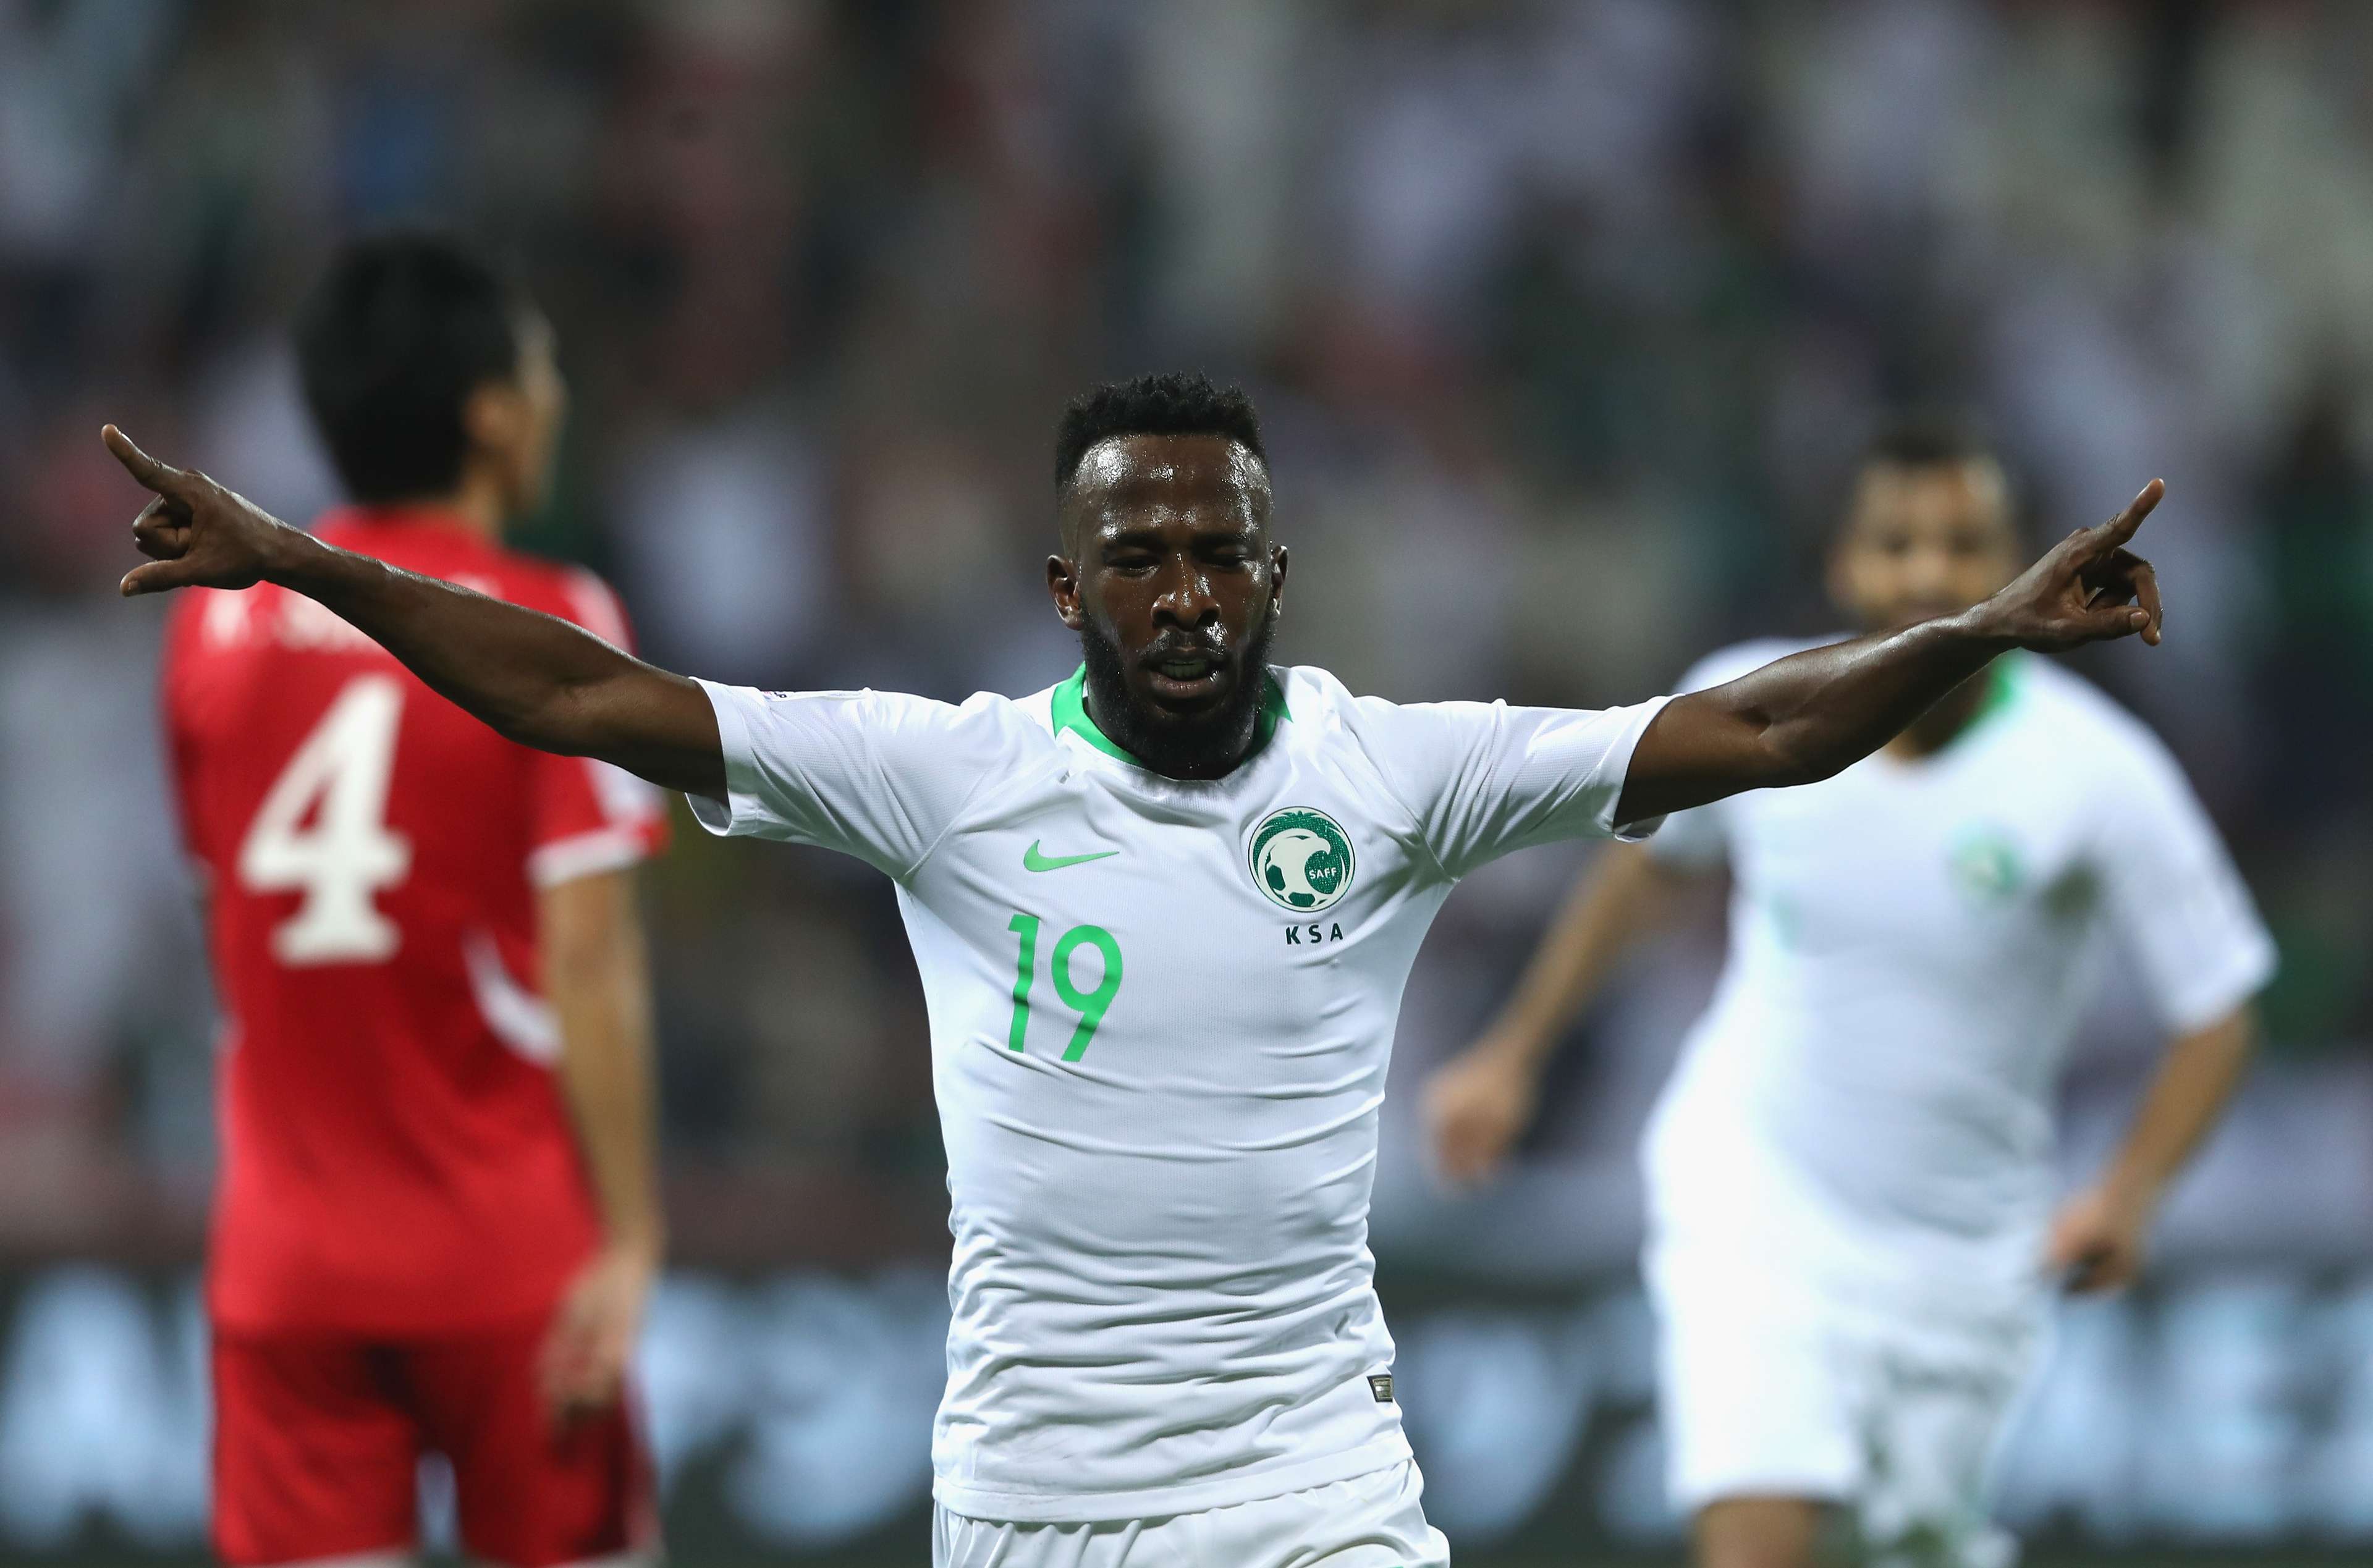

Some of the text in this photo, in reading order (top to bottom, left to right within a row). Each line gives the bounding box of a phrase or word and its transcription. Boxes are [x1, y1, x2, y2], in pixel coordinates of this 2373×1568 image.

[239, 672, 412, 964] 4
[1309, 867, 1337, 879] SAFF
[1285, 923, 1343, 945] KSA
[1007, 913, 1123, 1062] 19
